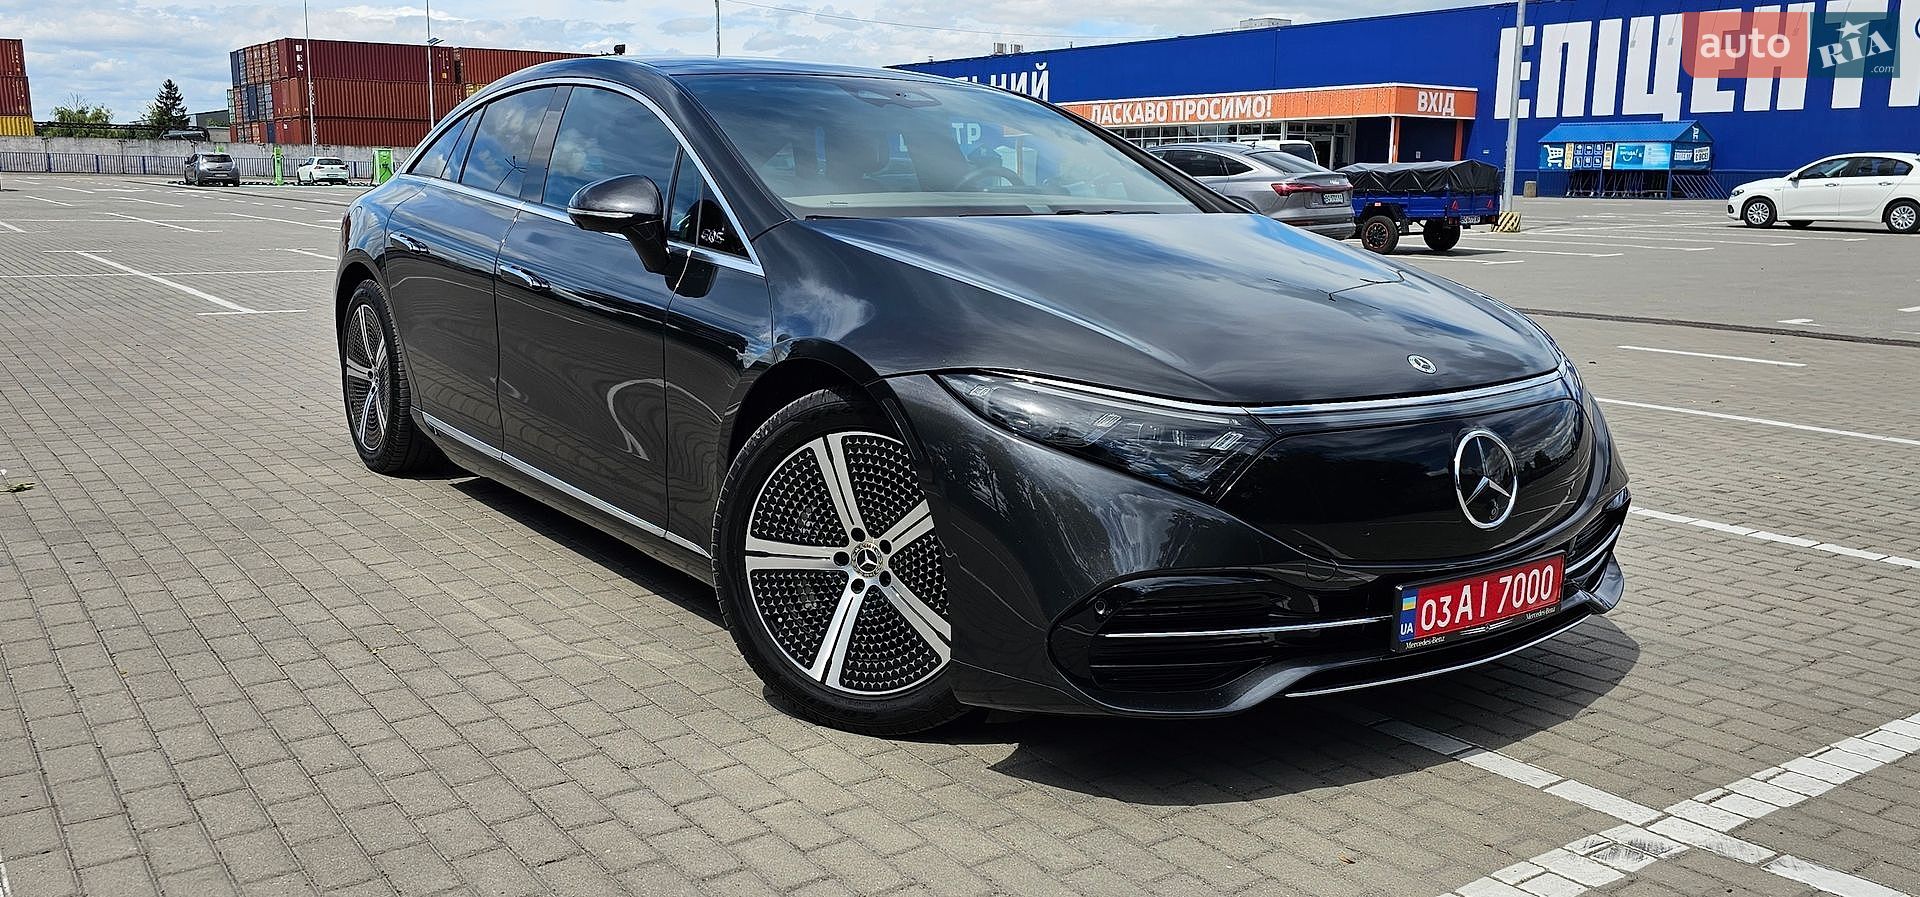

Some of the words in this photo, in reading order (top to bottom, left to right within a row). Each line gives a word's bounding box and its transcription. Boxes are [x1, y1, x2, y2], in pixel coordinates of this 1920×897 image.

[1091, 101, 1167, 125] ЛАСКАВО
[1172, 95, 1272, 121] ПРОСИМО!
[1417, 90, 1456, 117] ВХІД
[1525, 606, 1556, 621] Mercedes-Benz
[1401, 623, 1414, 636] UA
[1405, 635, 1446, 650] Mercedes-Benz
